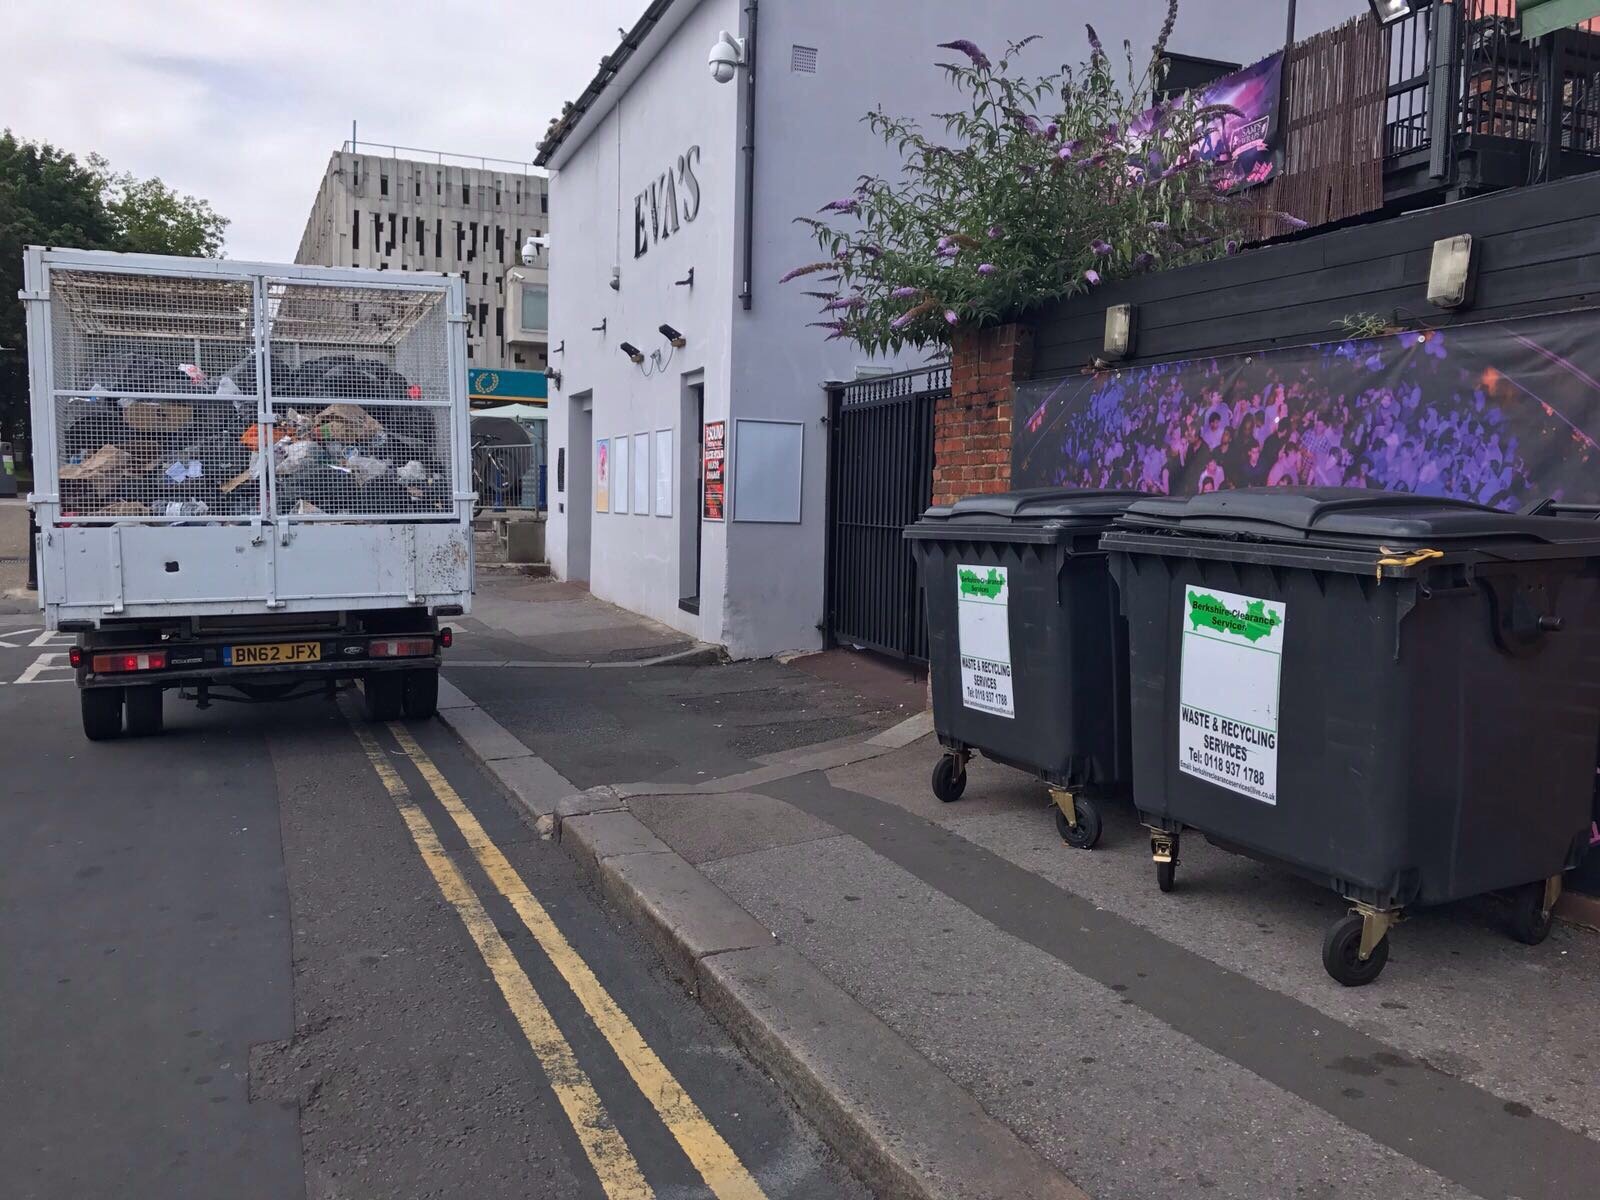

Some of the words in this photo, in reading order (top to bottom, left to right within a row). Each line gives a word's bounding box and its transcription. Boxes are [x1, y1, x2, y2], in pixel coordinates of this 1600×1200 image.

[634, 145, 701, 259] EVA'S
[235, 646, 280, 662] BN62
[285, 644, 317, 660] JFX
[961, 657, 977, 671] WASTE
[981, 661, 1011, 677] RECYCLING
[973, 674, 997, 690] SERVICES
[975, 688, 986, 701] 0118
[995, 693, 1008, 706] 1788
[1181, 706, 1210, 729] WASTE
[1212, 717, 1219, 732] &
[1221, 719, 1276, 749] RECYCLING
[1203, 734, 1248, 762] SERVICES
[1188, 746, 1203, 764] Tel:
[1204, 752, 1224, 772] 0118
[1225, 760, 1241, 778] 937
[1243, 766, 1265, 786] 1788
